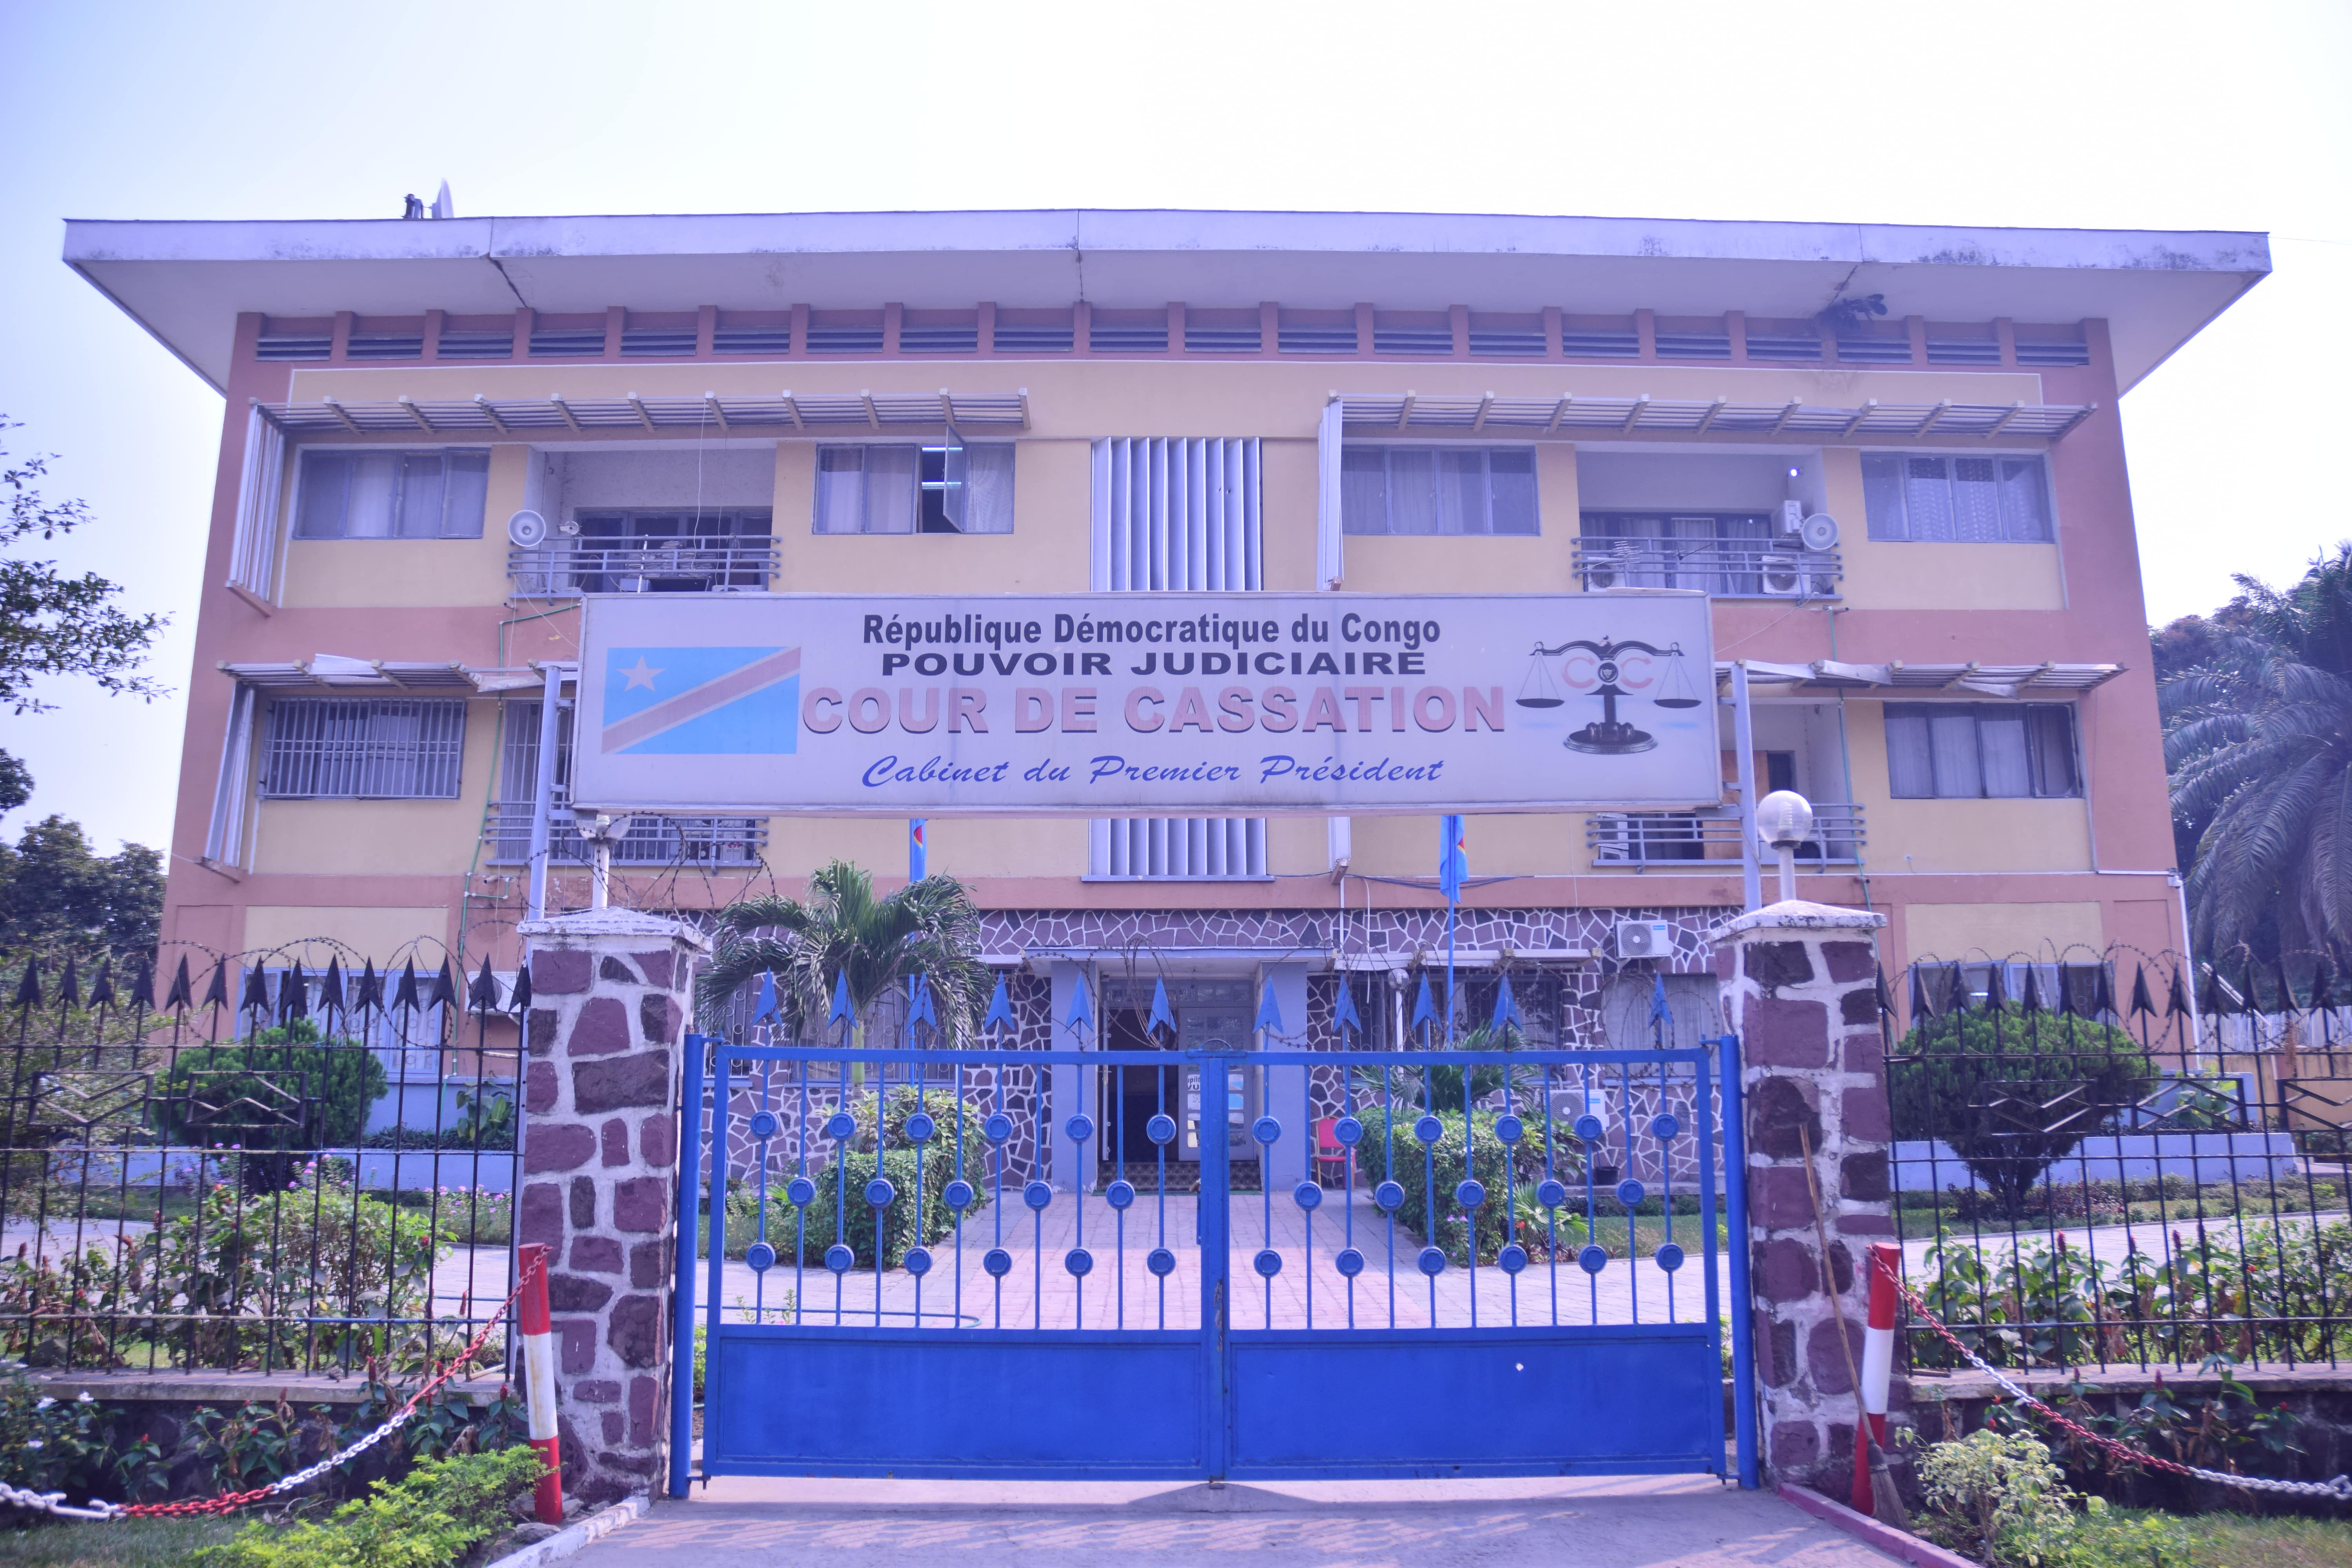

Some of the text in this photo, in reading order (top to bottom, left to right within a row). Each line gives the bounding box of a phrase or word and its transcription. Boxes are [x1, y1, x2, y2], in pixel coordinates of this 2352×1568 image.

[863, 612, 1441, 651] République Démocratique du Congo
[882, 652, 1426, 676] POUVOIR JUDICIAIRE
[802, 686, 1505, 734] COUR DE CASSATION
[862, 755, 1445, 788] Cabinet du Premier Président
